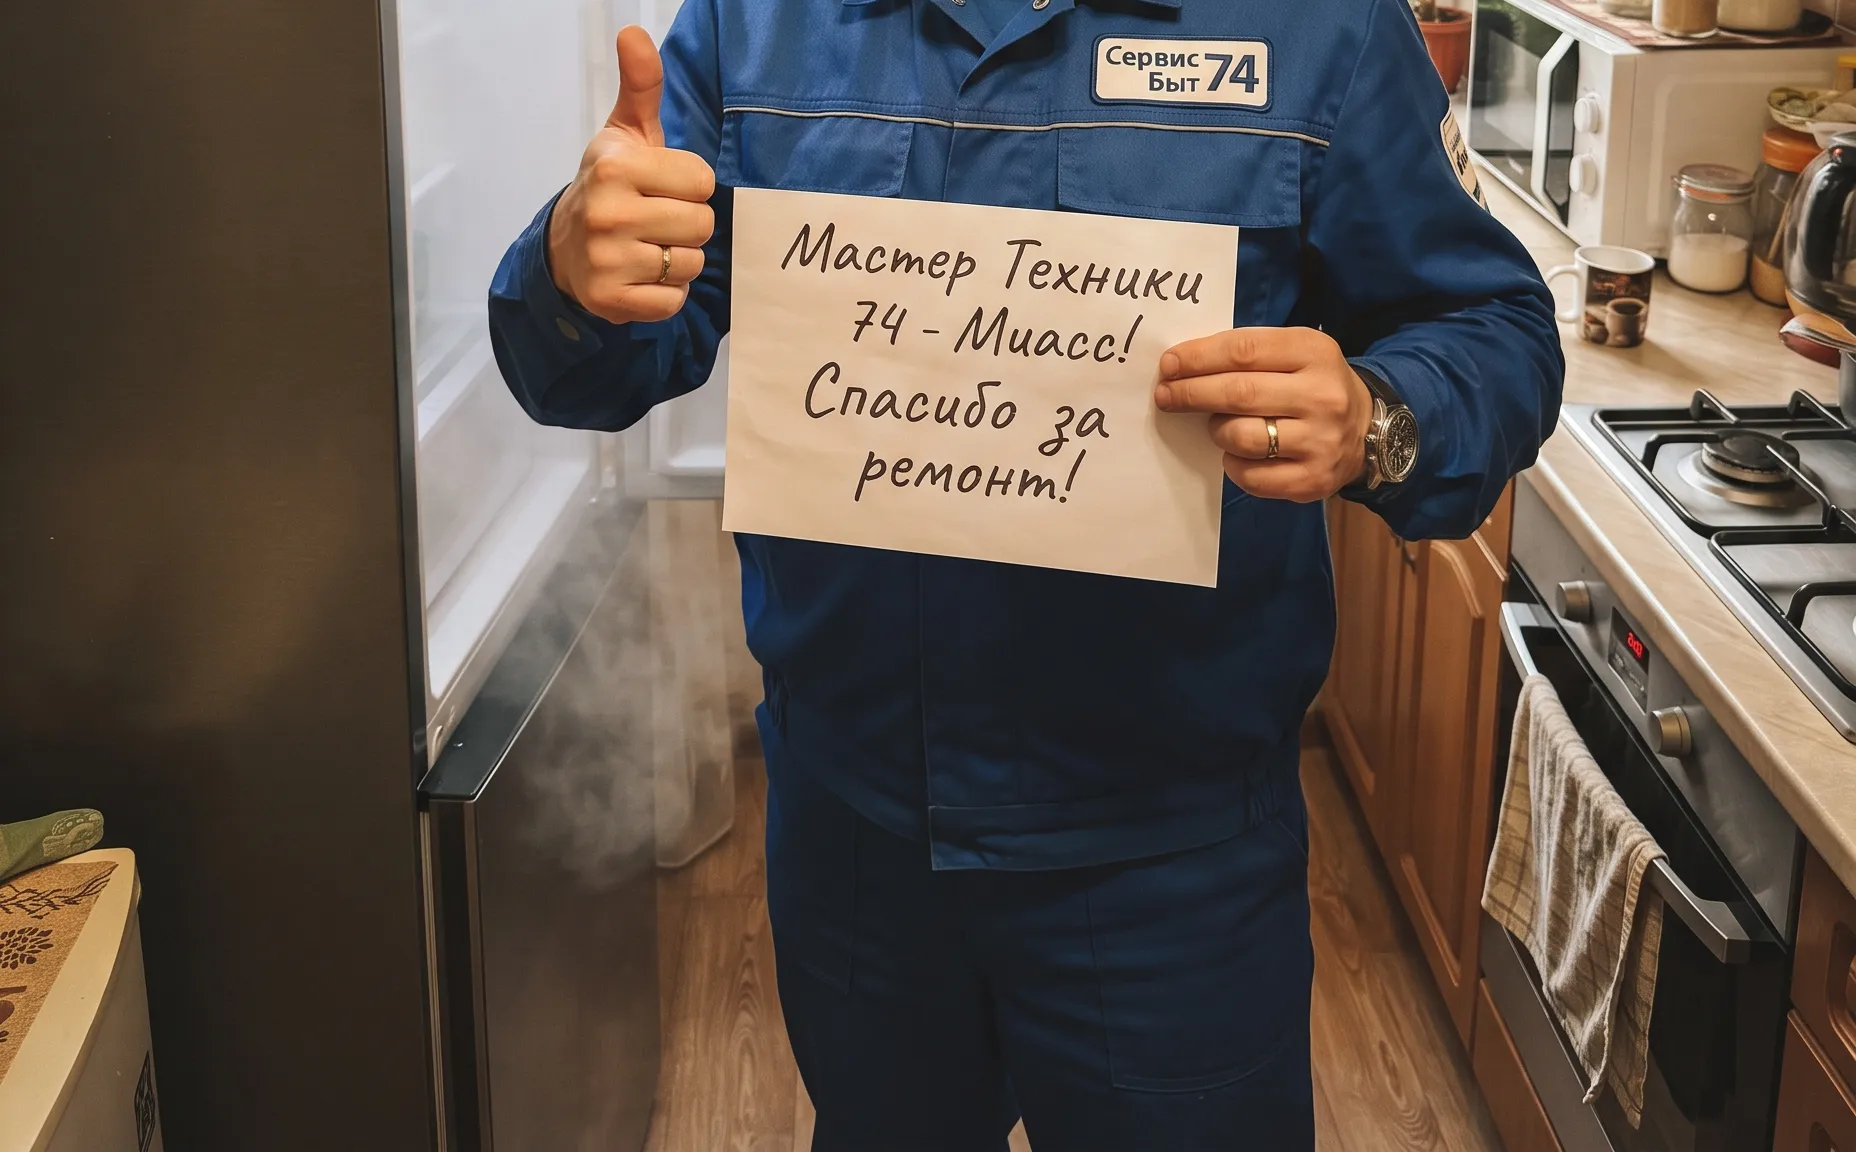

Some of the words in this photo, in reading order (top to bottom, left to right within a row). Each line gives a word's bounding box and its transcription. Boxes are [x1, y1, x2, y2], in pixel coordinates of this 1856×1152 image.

[1105, 45, 1200, 71] Сервис
[1149, 71, 1201, 93] Быт
[1204, 52, 1260, 94] 74
[780, 222, 977, 297] Мастер
[1004, 238, 1203, 305] Техники
[851, 300, 908, 346] 74
[953, 306, 1144, 364] Миасс!
[804, 361, 1017, 430] Спасибо
[1037, 404, 1110, 457] за
[854, 448, 1087, 504] ремонт!
